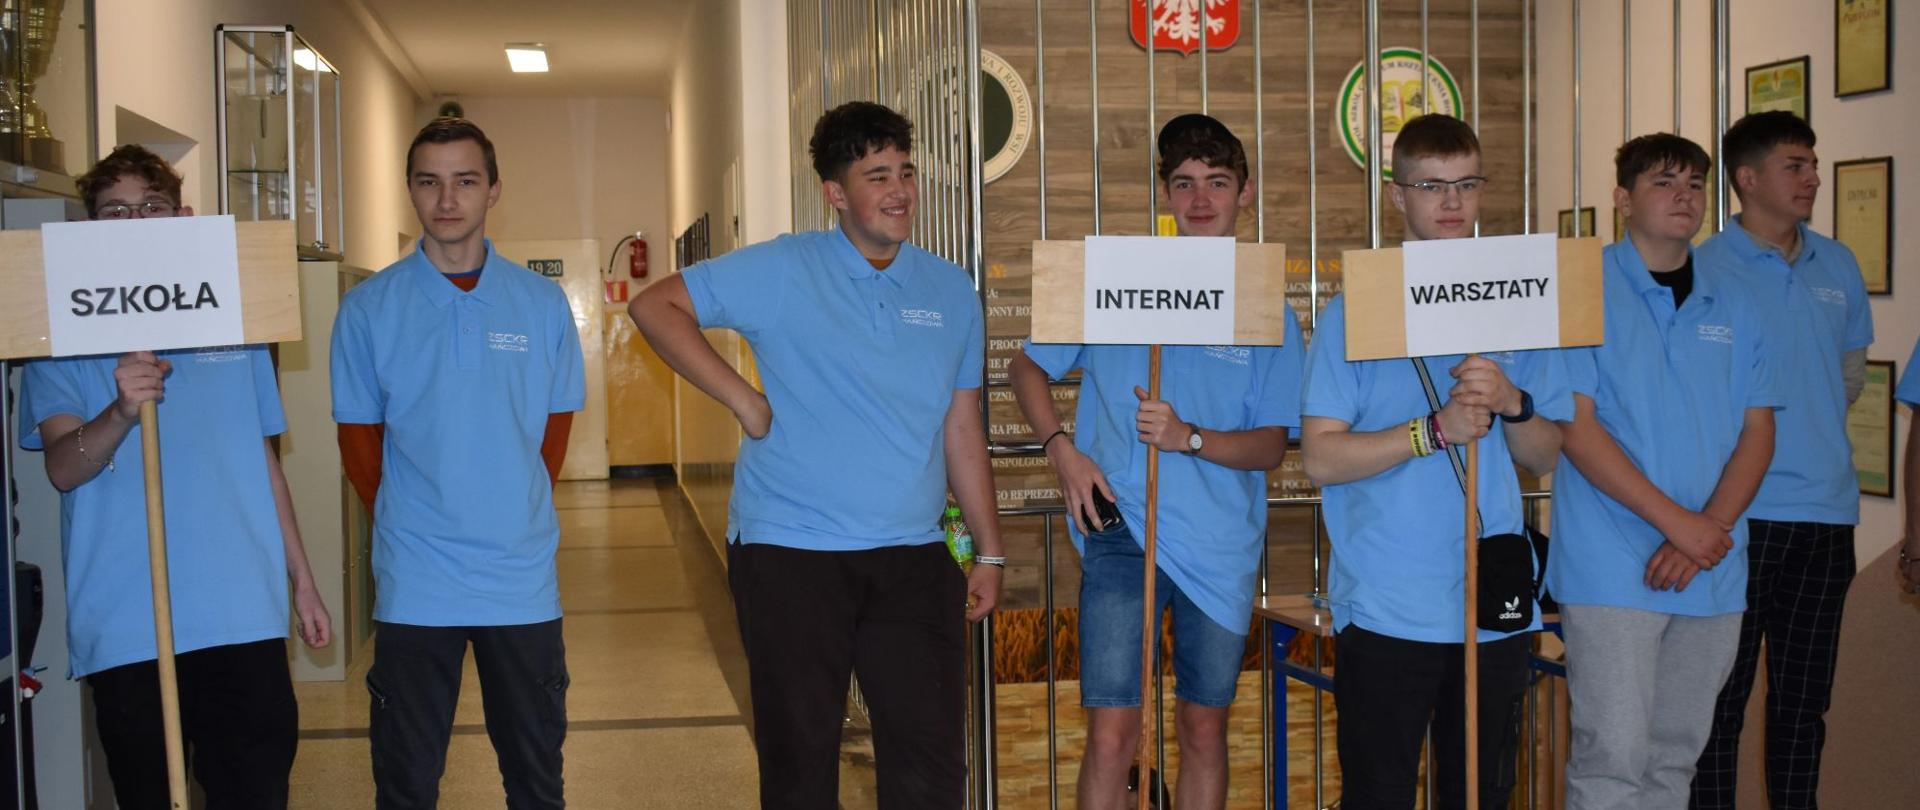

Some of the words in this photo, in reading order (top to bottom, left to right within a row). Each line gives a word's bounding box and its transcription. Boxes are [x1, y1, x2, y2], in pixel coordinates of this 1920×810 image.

[1009, 133, 1024, 154] WSI
[546, 261, 562, 275] 20
[70, 280, 220, 318] SZKOŁA
[1095, 288, 1226, 311] INTERNAT
[1410, 276, 1550, 306] WARSZTATY
